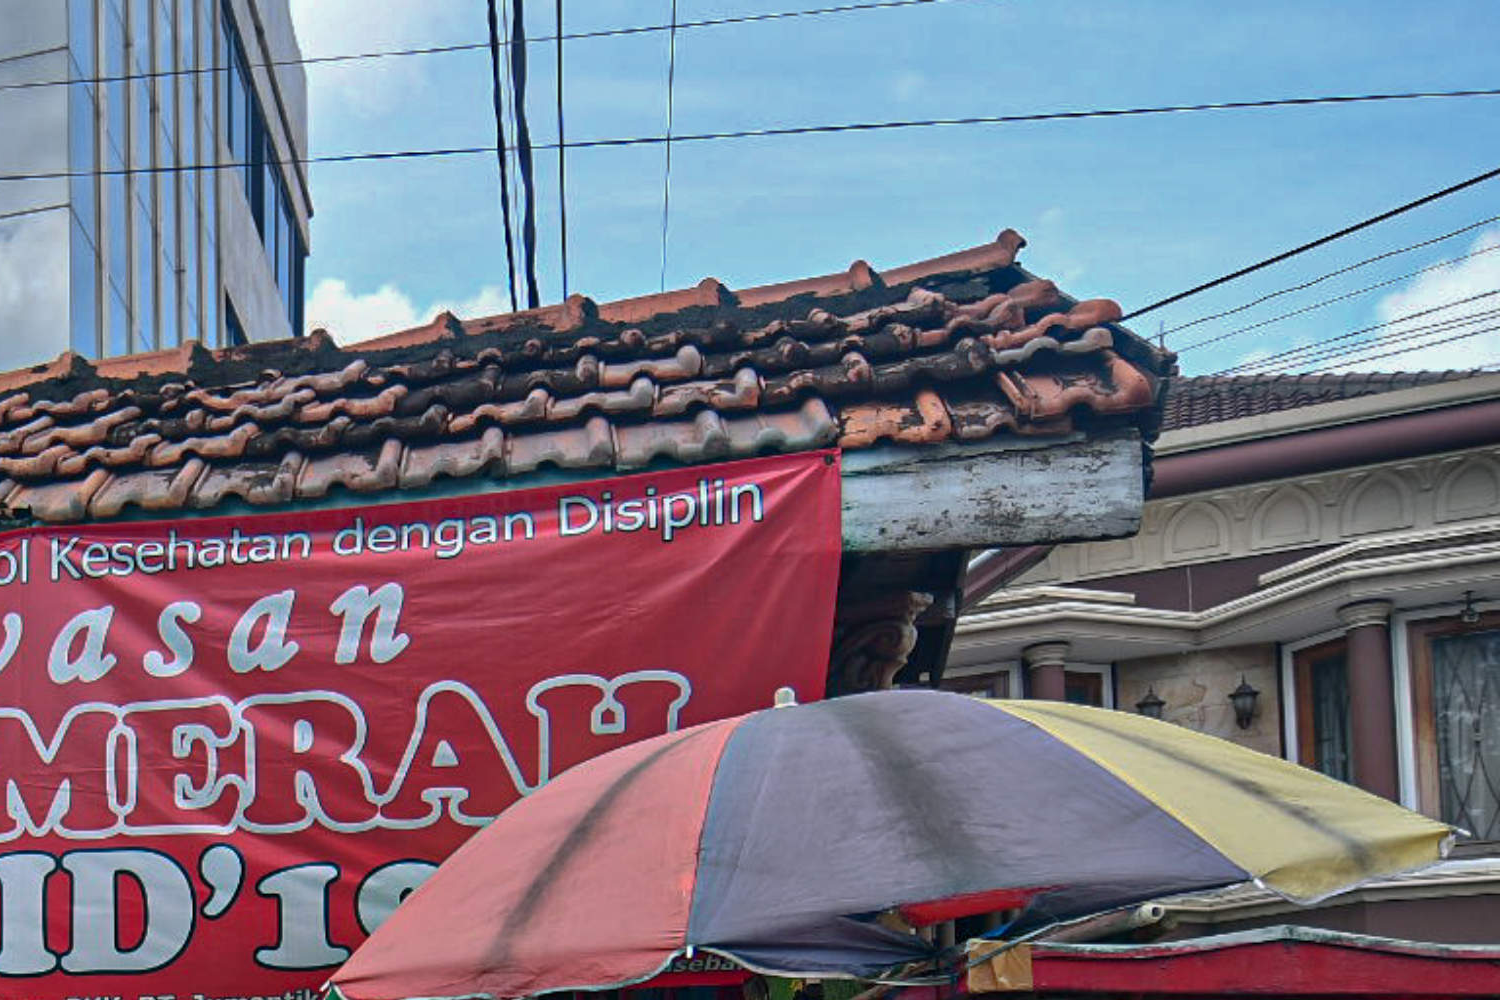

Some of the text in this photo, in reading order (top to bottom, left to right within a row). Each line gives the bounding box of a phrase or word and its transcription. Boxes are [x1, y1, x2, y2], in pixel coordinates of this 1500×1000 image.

[50, 528, 311, 583] Kesehatan
[333, 508, 534, 559] dengan
[558, 476, 764, 541] Disiplin
